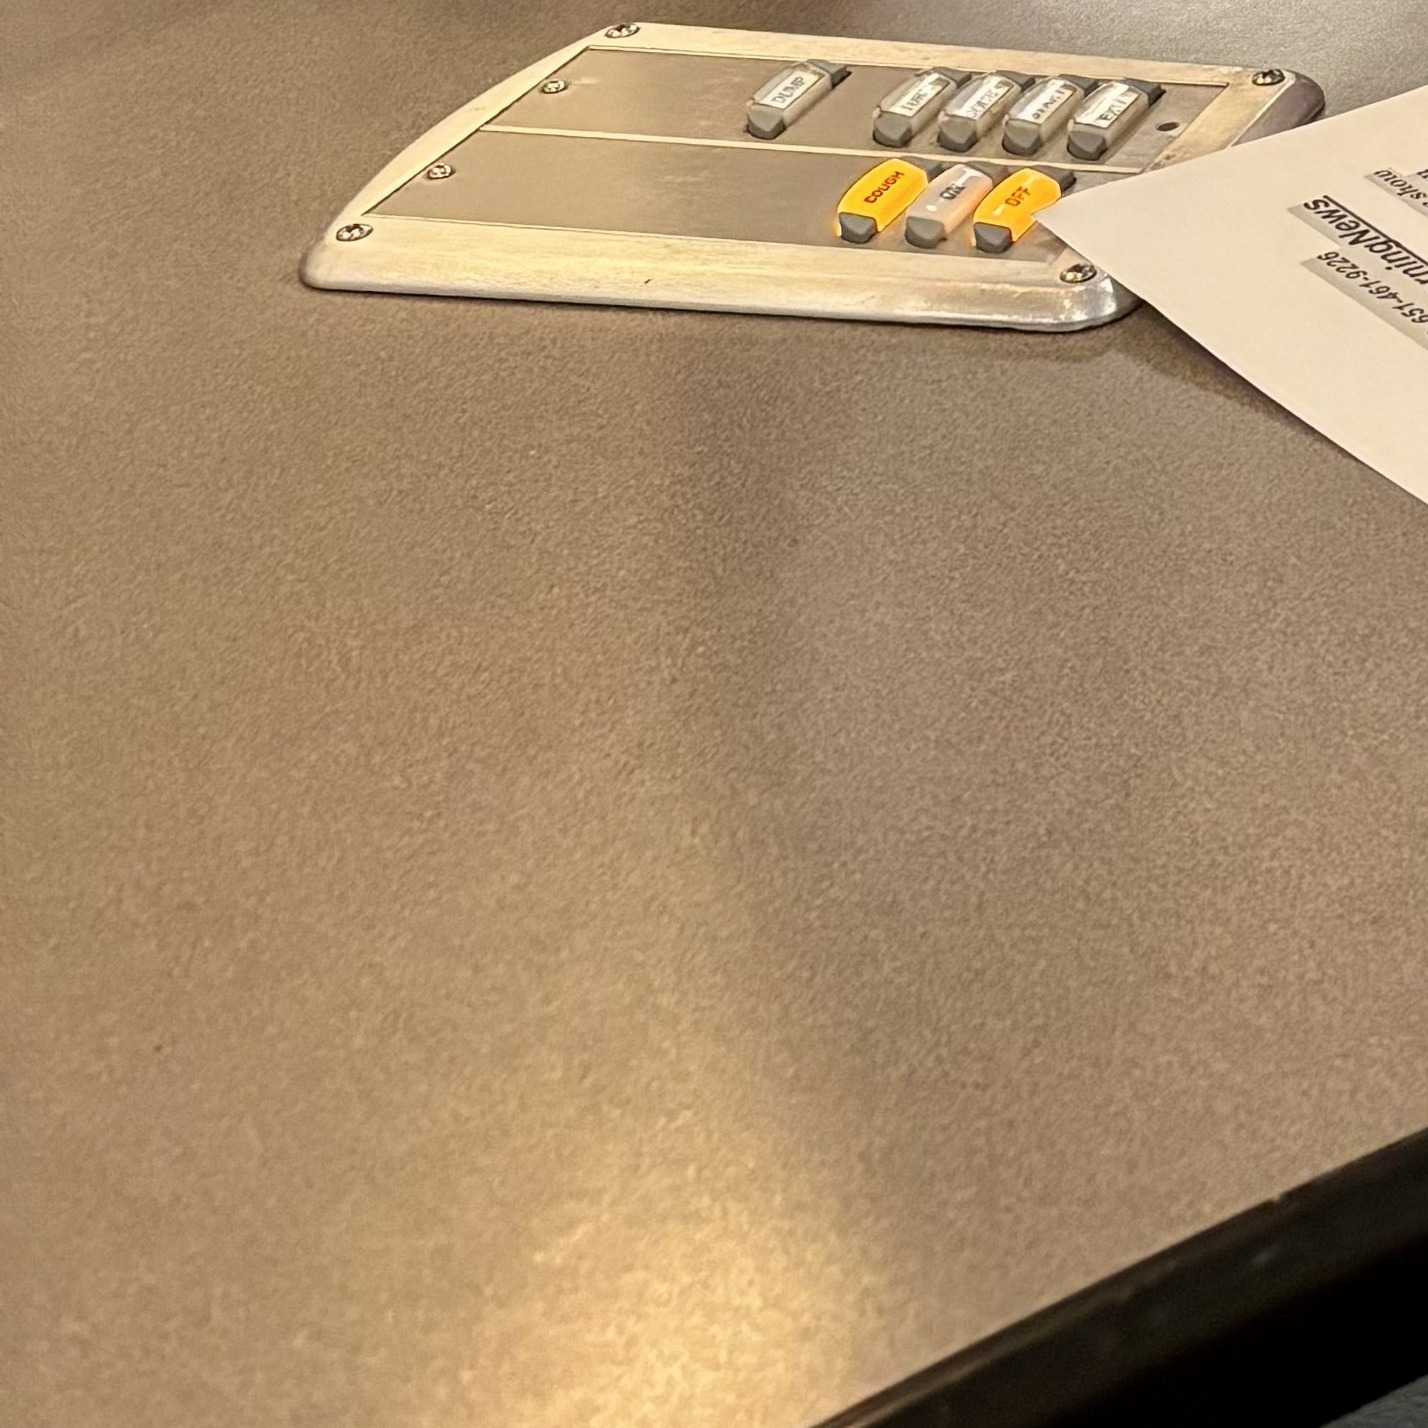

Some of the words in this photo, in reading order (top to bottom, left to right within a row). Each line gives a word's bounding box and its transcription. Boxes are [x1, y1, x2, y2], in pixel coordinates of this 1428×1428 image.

[770, 75, 805, 105] DUMP
[863, 169, 906, 205] COUGH
[939, 182, 967, 202] ON
[1004, 185, 1034, 208] OFF
[1367, 168, 1428, 203] show
